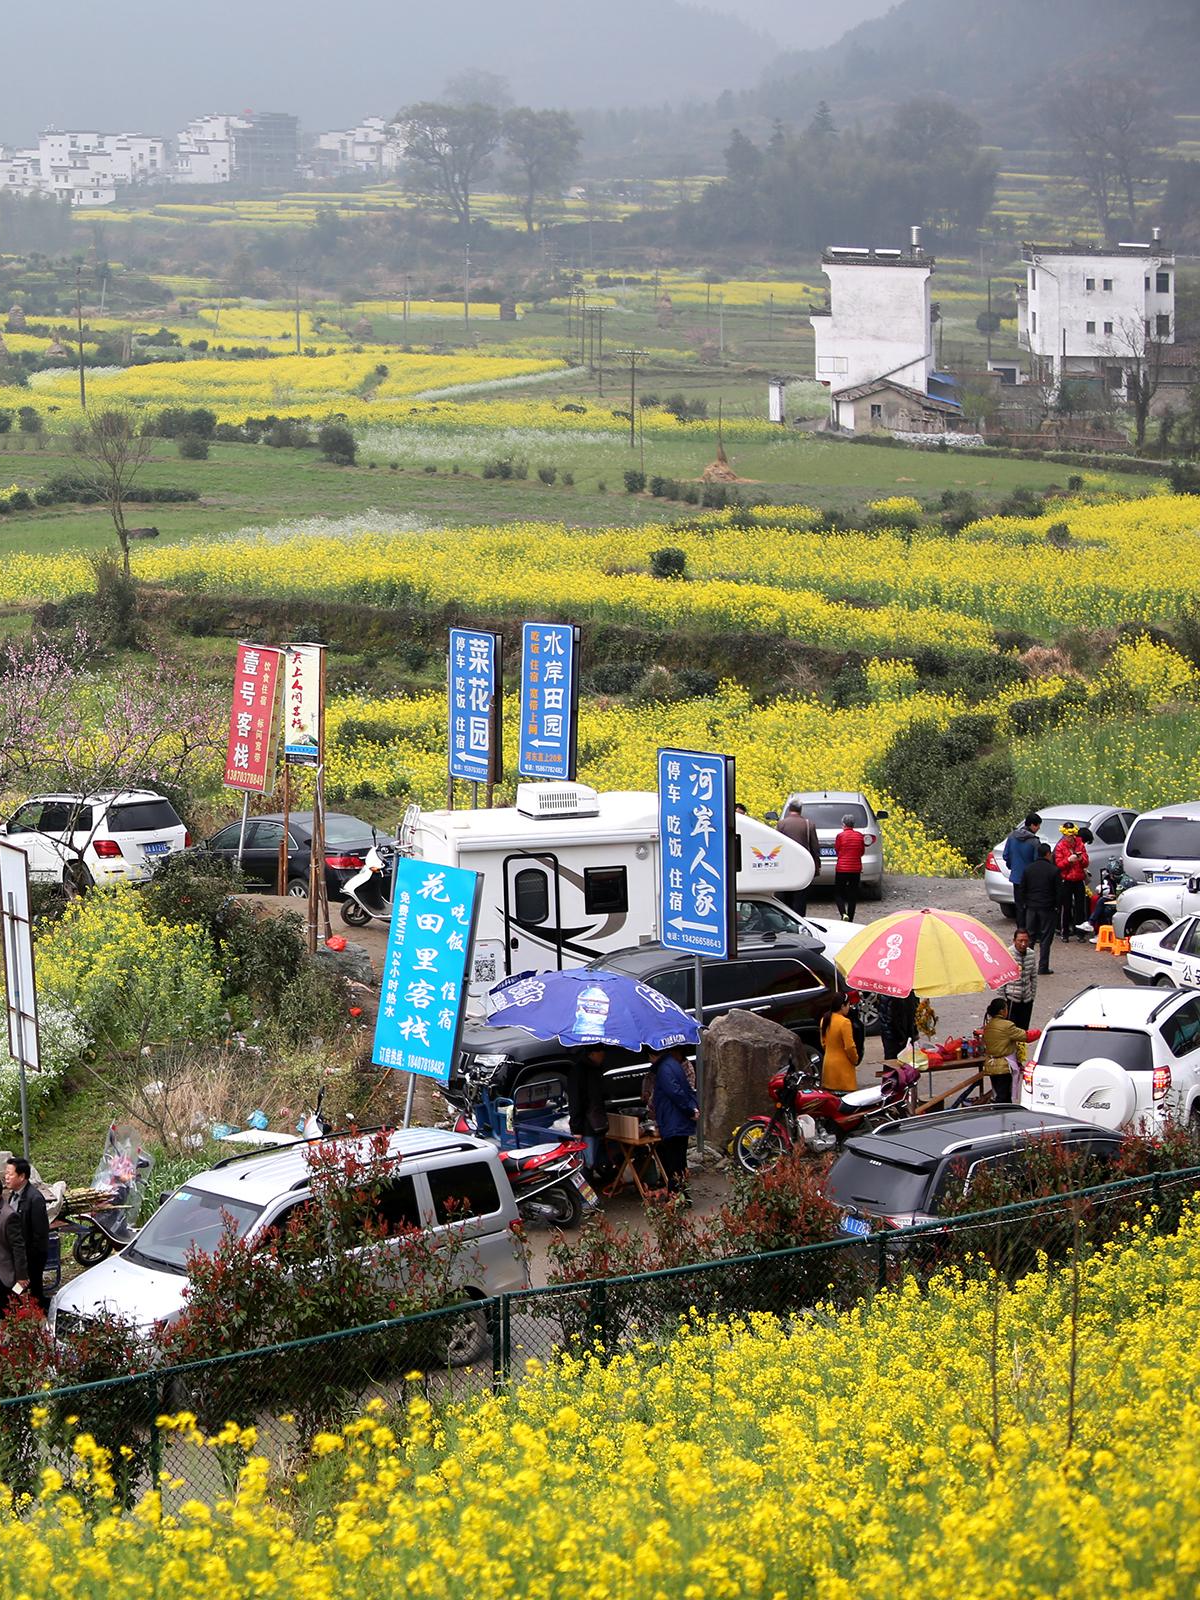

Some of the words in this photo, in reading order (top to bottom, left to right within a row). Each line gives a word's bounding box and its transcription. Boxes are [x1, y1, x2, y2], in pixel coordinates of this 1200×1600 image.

[456, 636, 466, 669] 停车
[530, 631, 540, 655] 吃饭
[259, 661, 272, 706] 饮食住宿
[455, 676, 466, 710] 吃饭
[468, 638, 490, 751] 菜花园
[529, 660, 540, 683] 住宿
[543, 631, 565, 738] 水岸田园
[233, 651, 260, 770] 壹号客栈
[455, 716, 466, 750] 住宿
[528, 688, 539, 735] 宽带上网
[667, 760, 681, 804] 停车
[667, 815, 683, 858] 吃饭
[688, 763, 721, 917] 河岸人家
[669, 868, 683, 912] 住宿
[394, 890, 411, 946] 免费WIFI
[445, 903, 469, 953] 吃饭
[397, 871, 451, 1048] 花田里客栈
[384, 951, 402, 1018] 24小时热水
[437, 981, 456, 1031] 住宿
